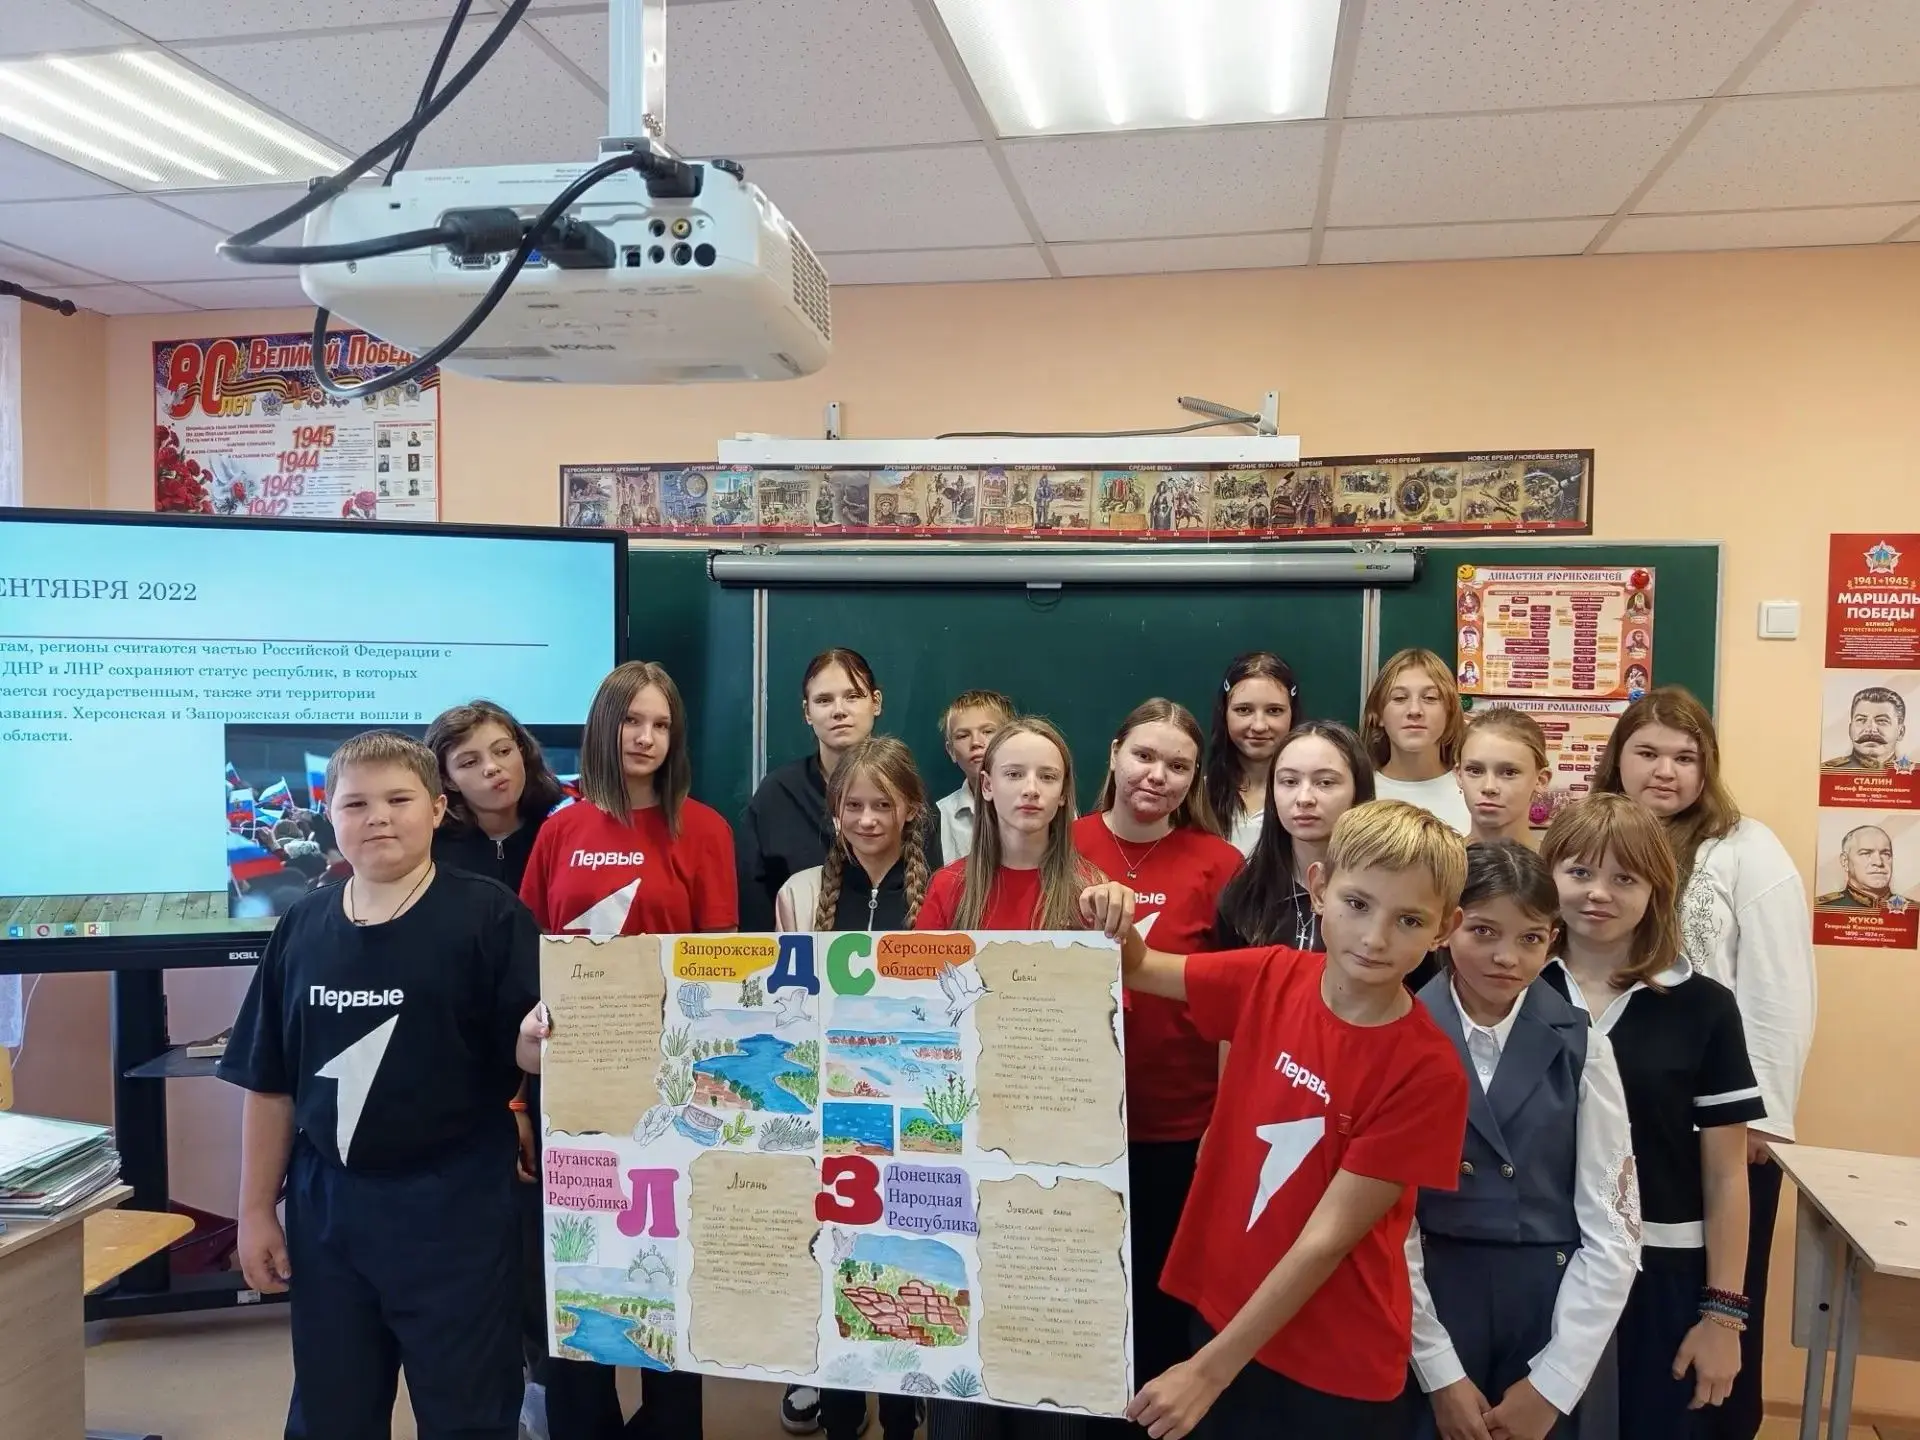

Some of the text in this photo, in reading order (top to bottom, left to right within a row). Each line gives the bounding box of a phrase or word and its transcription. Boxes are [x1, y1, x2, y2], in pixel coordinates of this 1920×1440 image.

[292, 425, 336, 449] 1945
[276, 451, 320, 472] 1944
[1518, 453, 1554, 461] НОВЕЙШЕЕ
[261, 474, 305, 497] 1943
[246, 498, 288, 516] 1942
[1488, 571, 1622, 581] ДИНАСТИЯ РЮРИКОВИЧЕЙ
[138, 582, 197, 601] 2022
[1847, 607, 1915, 621] ПОБЕДЫ
[40, 643, 108, 655] регионы
[114, 644, 197, 655] считаются
[202, 644, 257, 655] частью
[263, 642, 349, 657] Российской
[354, 644, 440, 659] Федерации
[444, 648, 452, 658] с
[2, 661, 417, 681] ДНР и ЛНР сохраняют статус республик, в которых
[52, 687, 199, 700] государственным,
[203, 689, 252, 699] также
[256, 689, 281, 699] эти
[286, 689, 376, 701] территории
[0, 706, 422, 723] звания. Херсонская и Запорожская области вошли в
[1547, 703, 1611, 712] РОМАНОВЫХ
[3, 729, 73, 742] области.
[1854, 777, 1892, 785] СТАЛИН
[1859, 785, 1911, 793] Виссарионович
[569, 849, 645, 871] Первые
[1824, 922, 1907, 932] Георгий Константинович
[1849, 916, 1884, 925] ЖУКОВ
[229, 951, 259, 960] EXELL
[679, 941, 775, 959] Запорожская
[881, 940, 970, 957] Херсонская
[680, 962, 736, 978] область
[767, 935, 820, 996] Д
[826, 933, 875, 996] С
[310, 985, 404, 1013] Первые
[1274, 1051, 1331, 1105] Перв
[547, 1150, 617, 1169] Луганская
[548, 1171, 613, 1189] Народная
[887, 1165, 962, 1186] Донецкая
[815, 1155, 883, 1225] З
[888, 1188, 962, 1208] Народная
[549, 1192, 628, 1211] Республика
[617, 1168, 680, 1238] Л
[888, 1211, 977, 1233] Республика
